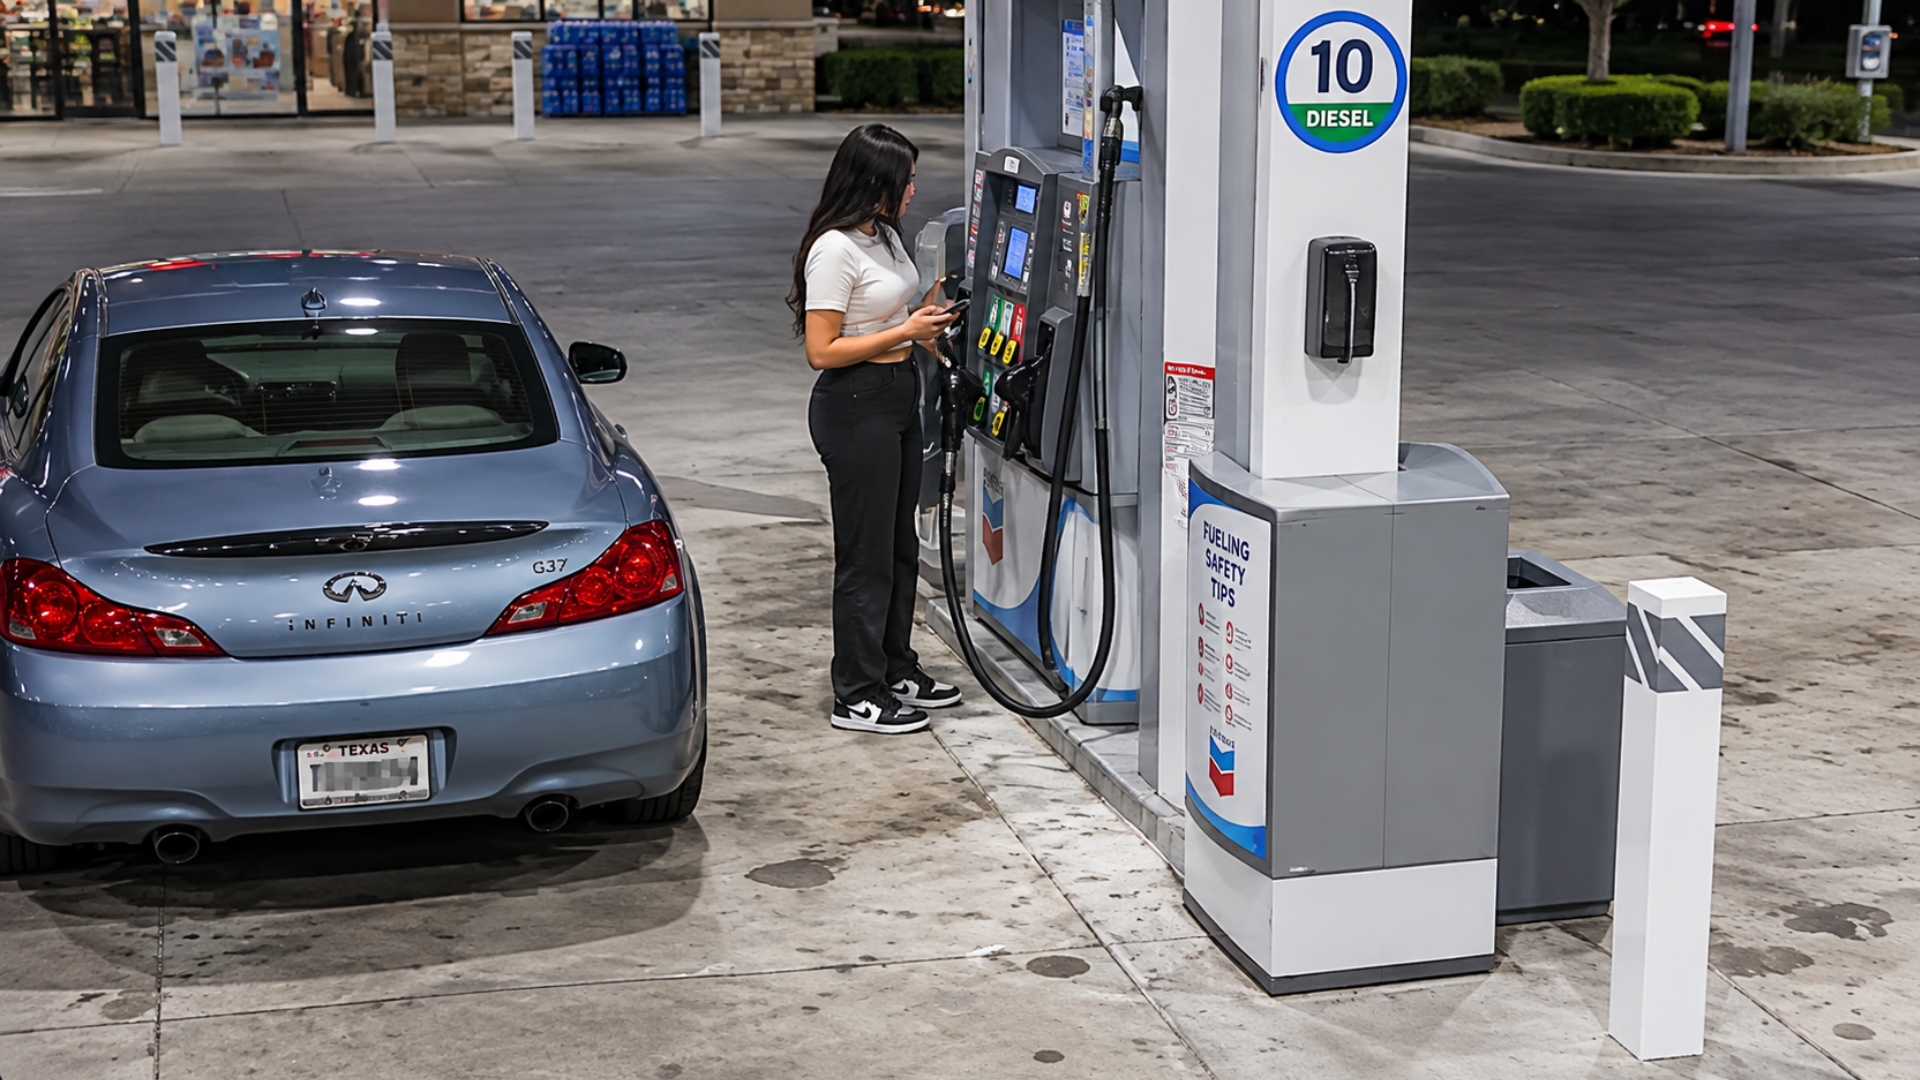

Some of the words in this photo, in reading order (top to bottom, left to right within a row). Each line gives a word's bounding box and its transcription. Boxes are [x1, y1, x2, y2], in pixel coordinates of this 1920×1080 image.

[1311, 38, 1374, 94] 10
[1306, 109, 1374, 128] DIESEL
[1203, 519, 1250, 562] FUELING
[532, 558, 568, 574] G37
[1205, 547, 1246, 586] SAFETY
[1210, 576, 1236, 608] TIPS
[288, 611, 423, 631] INFINITI
[338, 742, 390, 757] TEXAS
